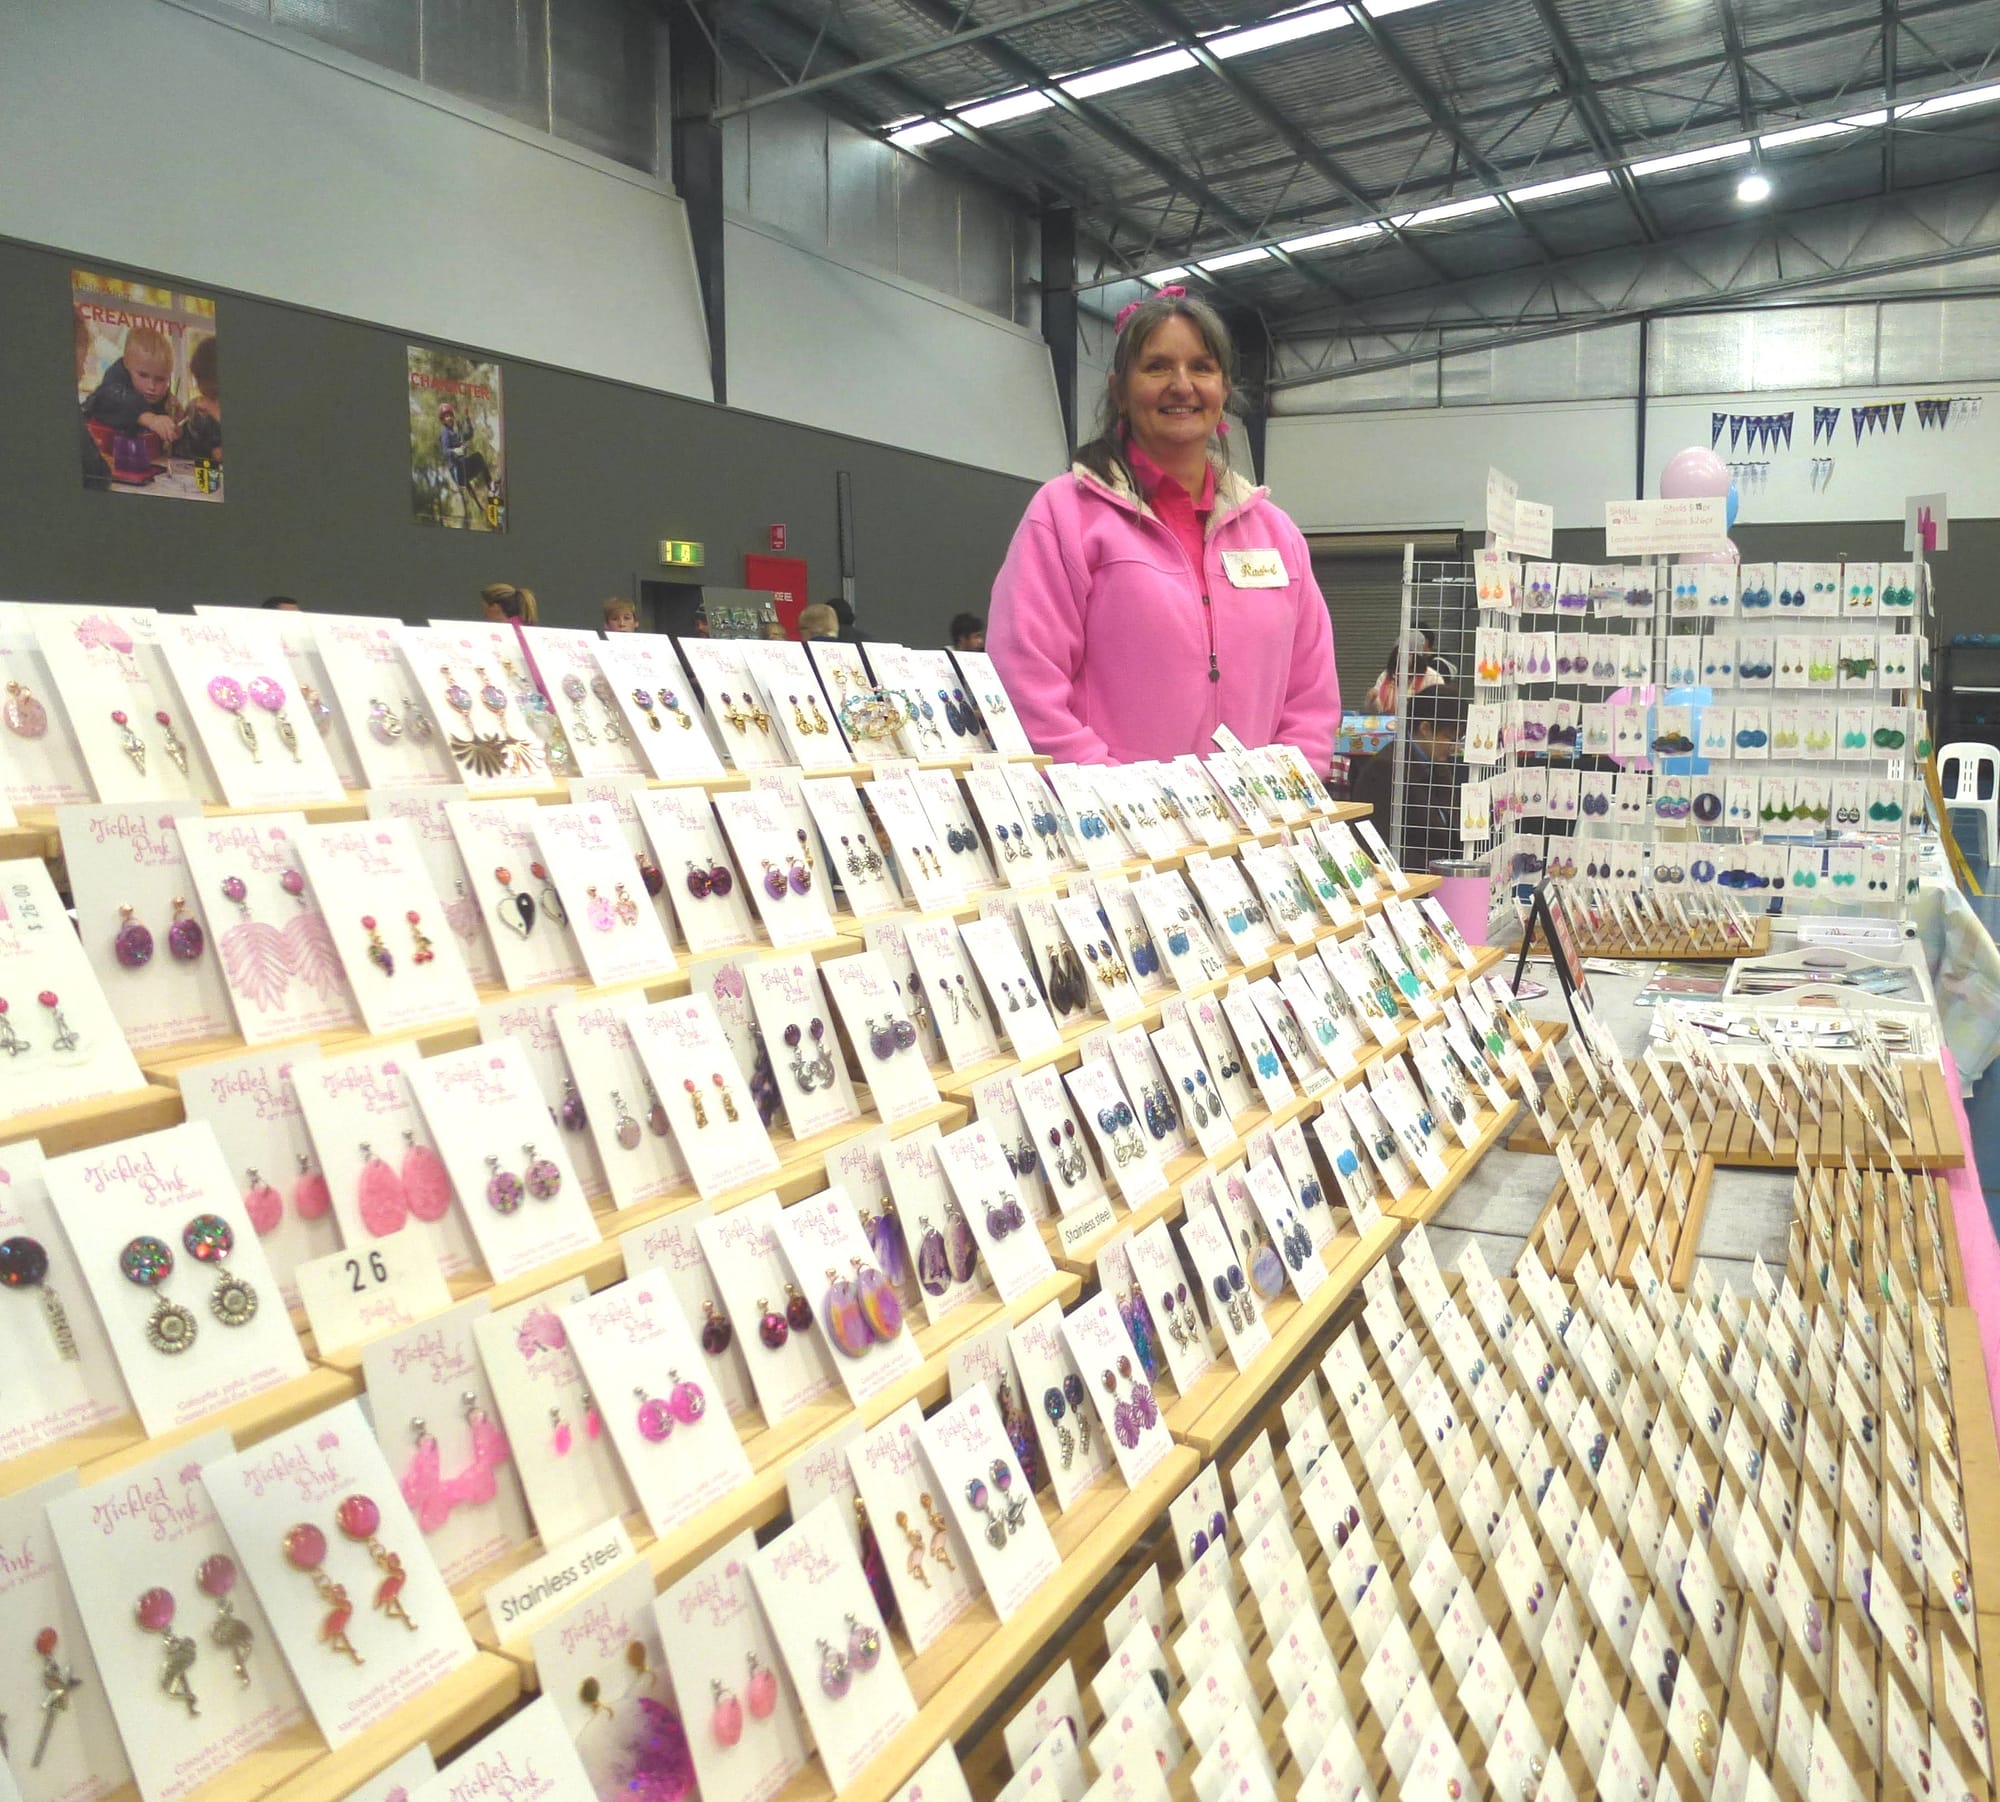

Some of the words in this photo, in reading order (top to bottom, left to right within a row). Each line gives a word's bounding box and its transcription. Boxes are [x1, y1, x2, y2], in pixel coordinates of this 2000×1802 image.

[79, 303, 187, 339] CREATIVITY
[89, 813, 148, 844] Tickled
[132, 831, 170, 863] Pink
[211, 1065, 270, 1104] Tickled
[84, 1152, 157, 1193] Tickled
[138, 1164, 189, 1205] Pink
[1094, 1207, 1112, 1226] steel
[345, 1251, 388, 1293] 26
[243, 1444, 312, 1497] Tickled
[295, 1455, 339, 1502] Pink
[91, 1476, 169, 1536] Tickled
[149, 1484, 200, 1542] Pink
[500, 1566, 579, 1622] Stainless
[580, 1536, 623, 1576] steel
[449, 1750, 512, 1802] Tickled
